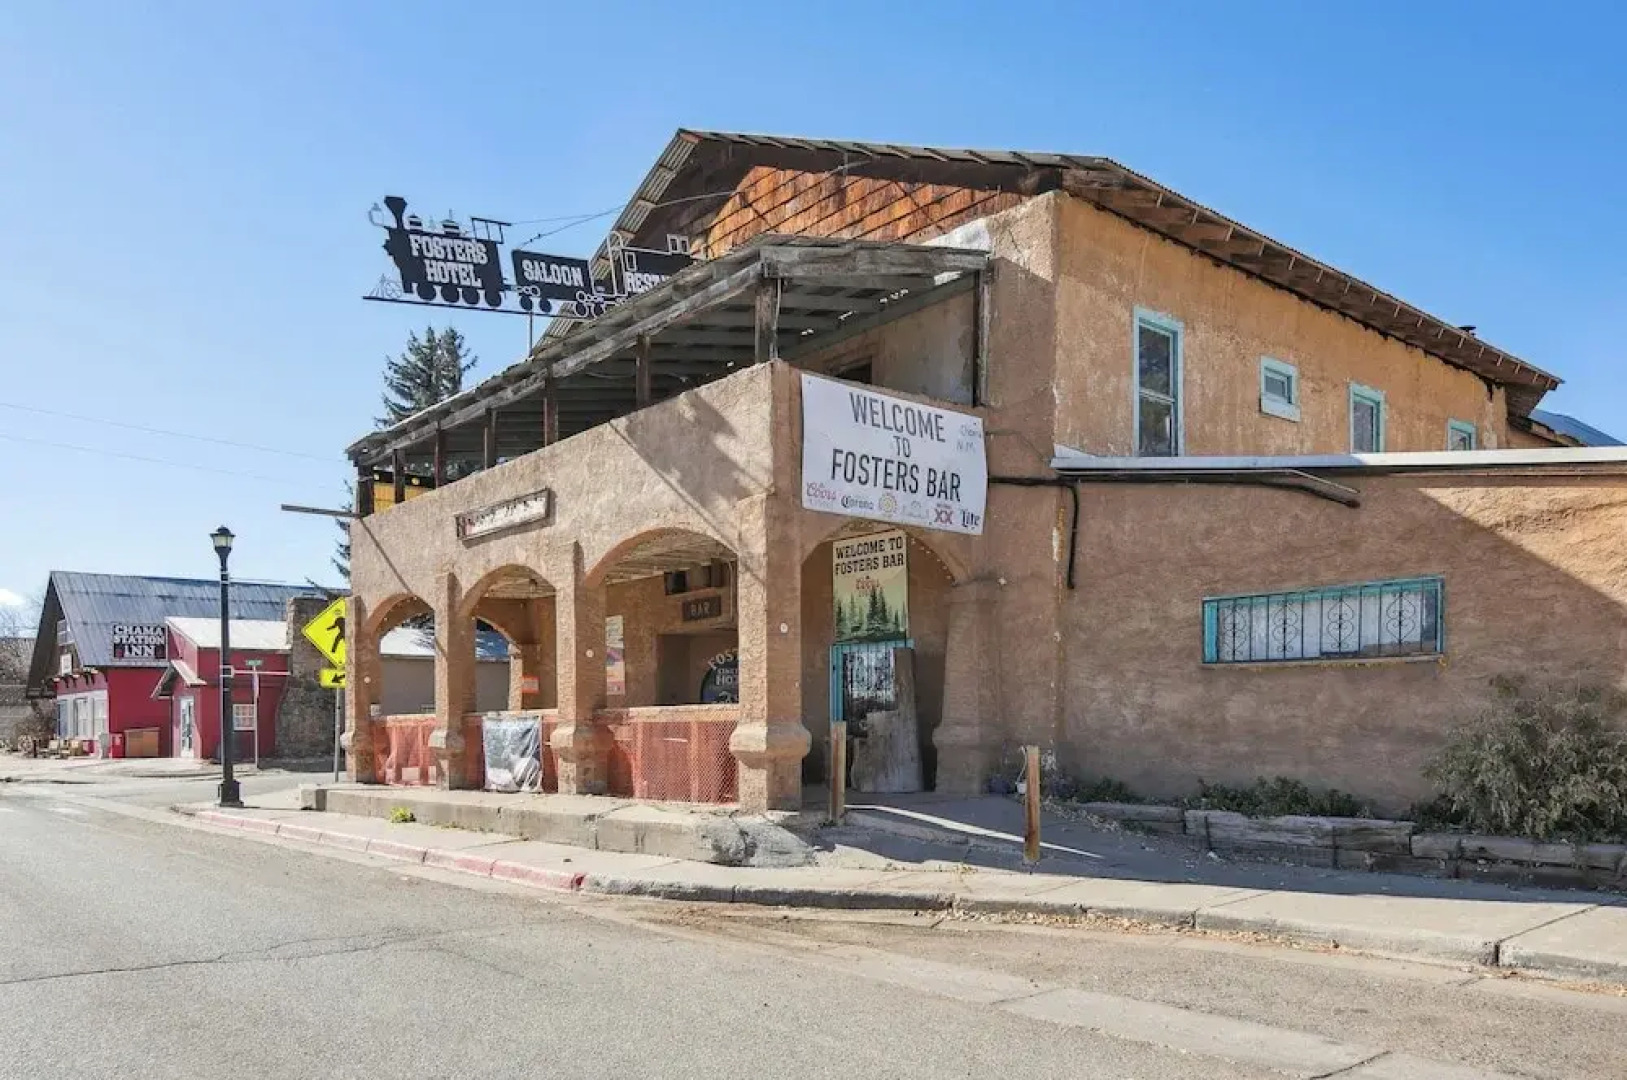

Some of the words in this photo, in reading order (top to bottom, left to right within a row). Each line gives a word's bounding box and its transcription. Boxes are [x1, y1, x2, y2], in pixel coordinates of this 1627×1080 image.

[424, 259, 482, 287] HOTEL
[522, 260, 584, 287] SALOON
[849, 392, 946, 442] WELCOME
[893, 435, 912, 457] TO
[831, 448, 920, 494] FOSTERS
[926, 467, 961, 502] BAR
[835, 540, 886, 559] WELCOME
[887, 536, 904, 551] TO
[835, 556, 880, 576] FOSTERS
[883, 552, 904, 569] BAR
[113, 635, 165, 645] STATION
[115, 625, 164, 635] CHAMA
[124, 645, 156, 657] INN
